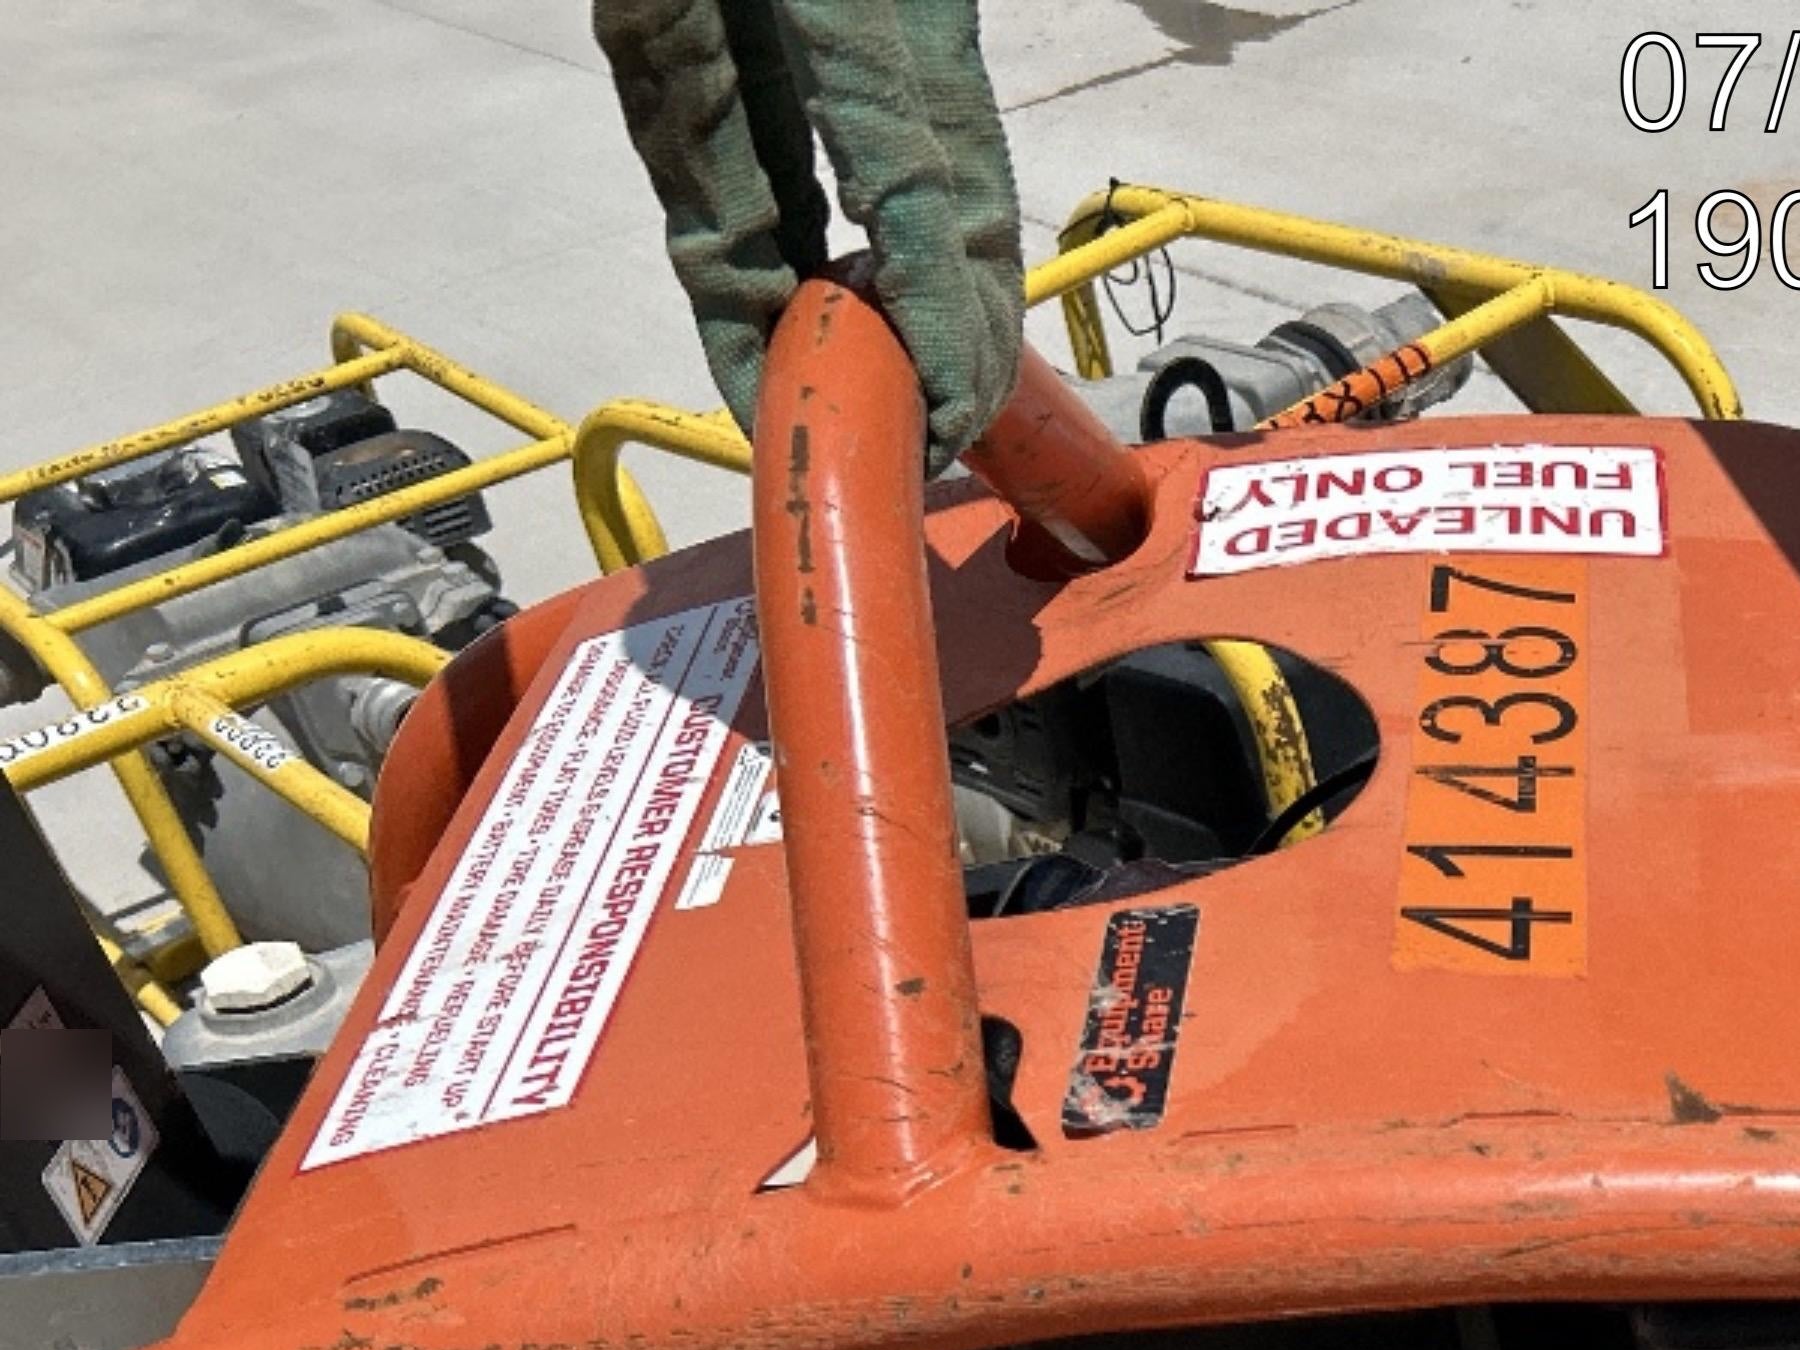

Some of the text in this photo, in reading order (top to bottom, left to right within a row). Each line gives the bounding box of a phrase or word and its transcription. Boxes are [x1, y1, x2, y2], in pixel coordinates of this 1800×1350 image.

[1224, 505, 1638, 557] UNLEADED
[1229, 460, 1634, 519] FUEL ONLY
[1400, 565, 1578, 960] 414387
[510, 693, 725, 1109] CUSTOMER RESPONSIBILITY
